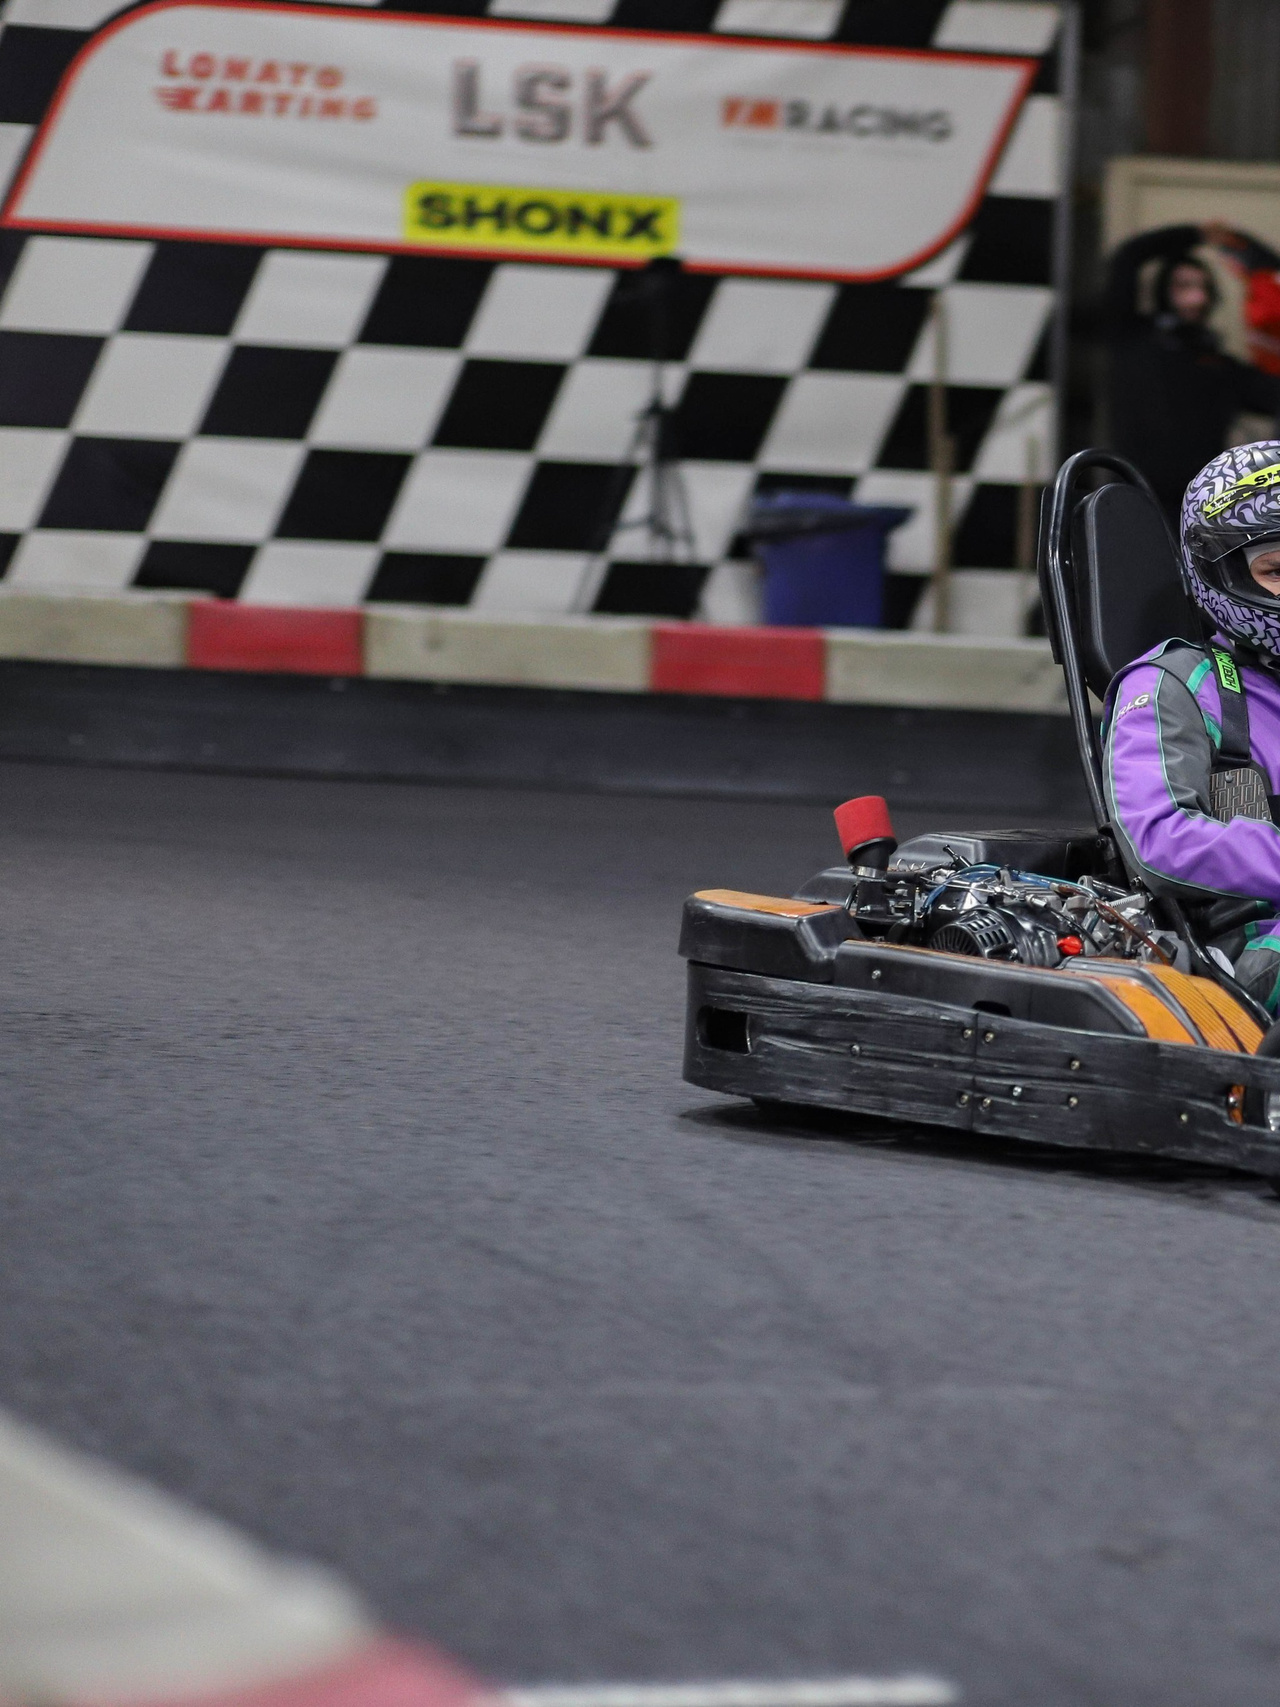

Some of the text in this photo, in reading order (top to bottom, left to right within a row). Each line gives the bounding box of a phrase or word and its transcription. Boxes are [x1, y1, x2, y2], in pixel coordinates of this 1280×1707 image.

[454, 58, 656, 150] LSK
[786, 97, 953, 142] RACING
[417, 193, 664, 243] SHONX
